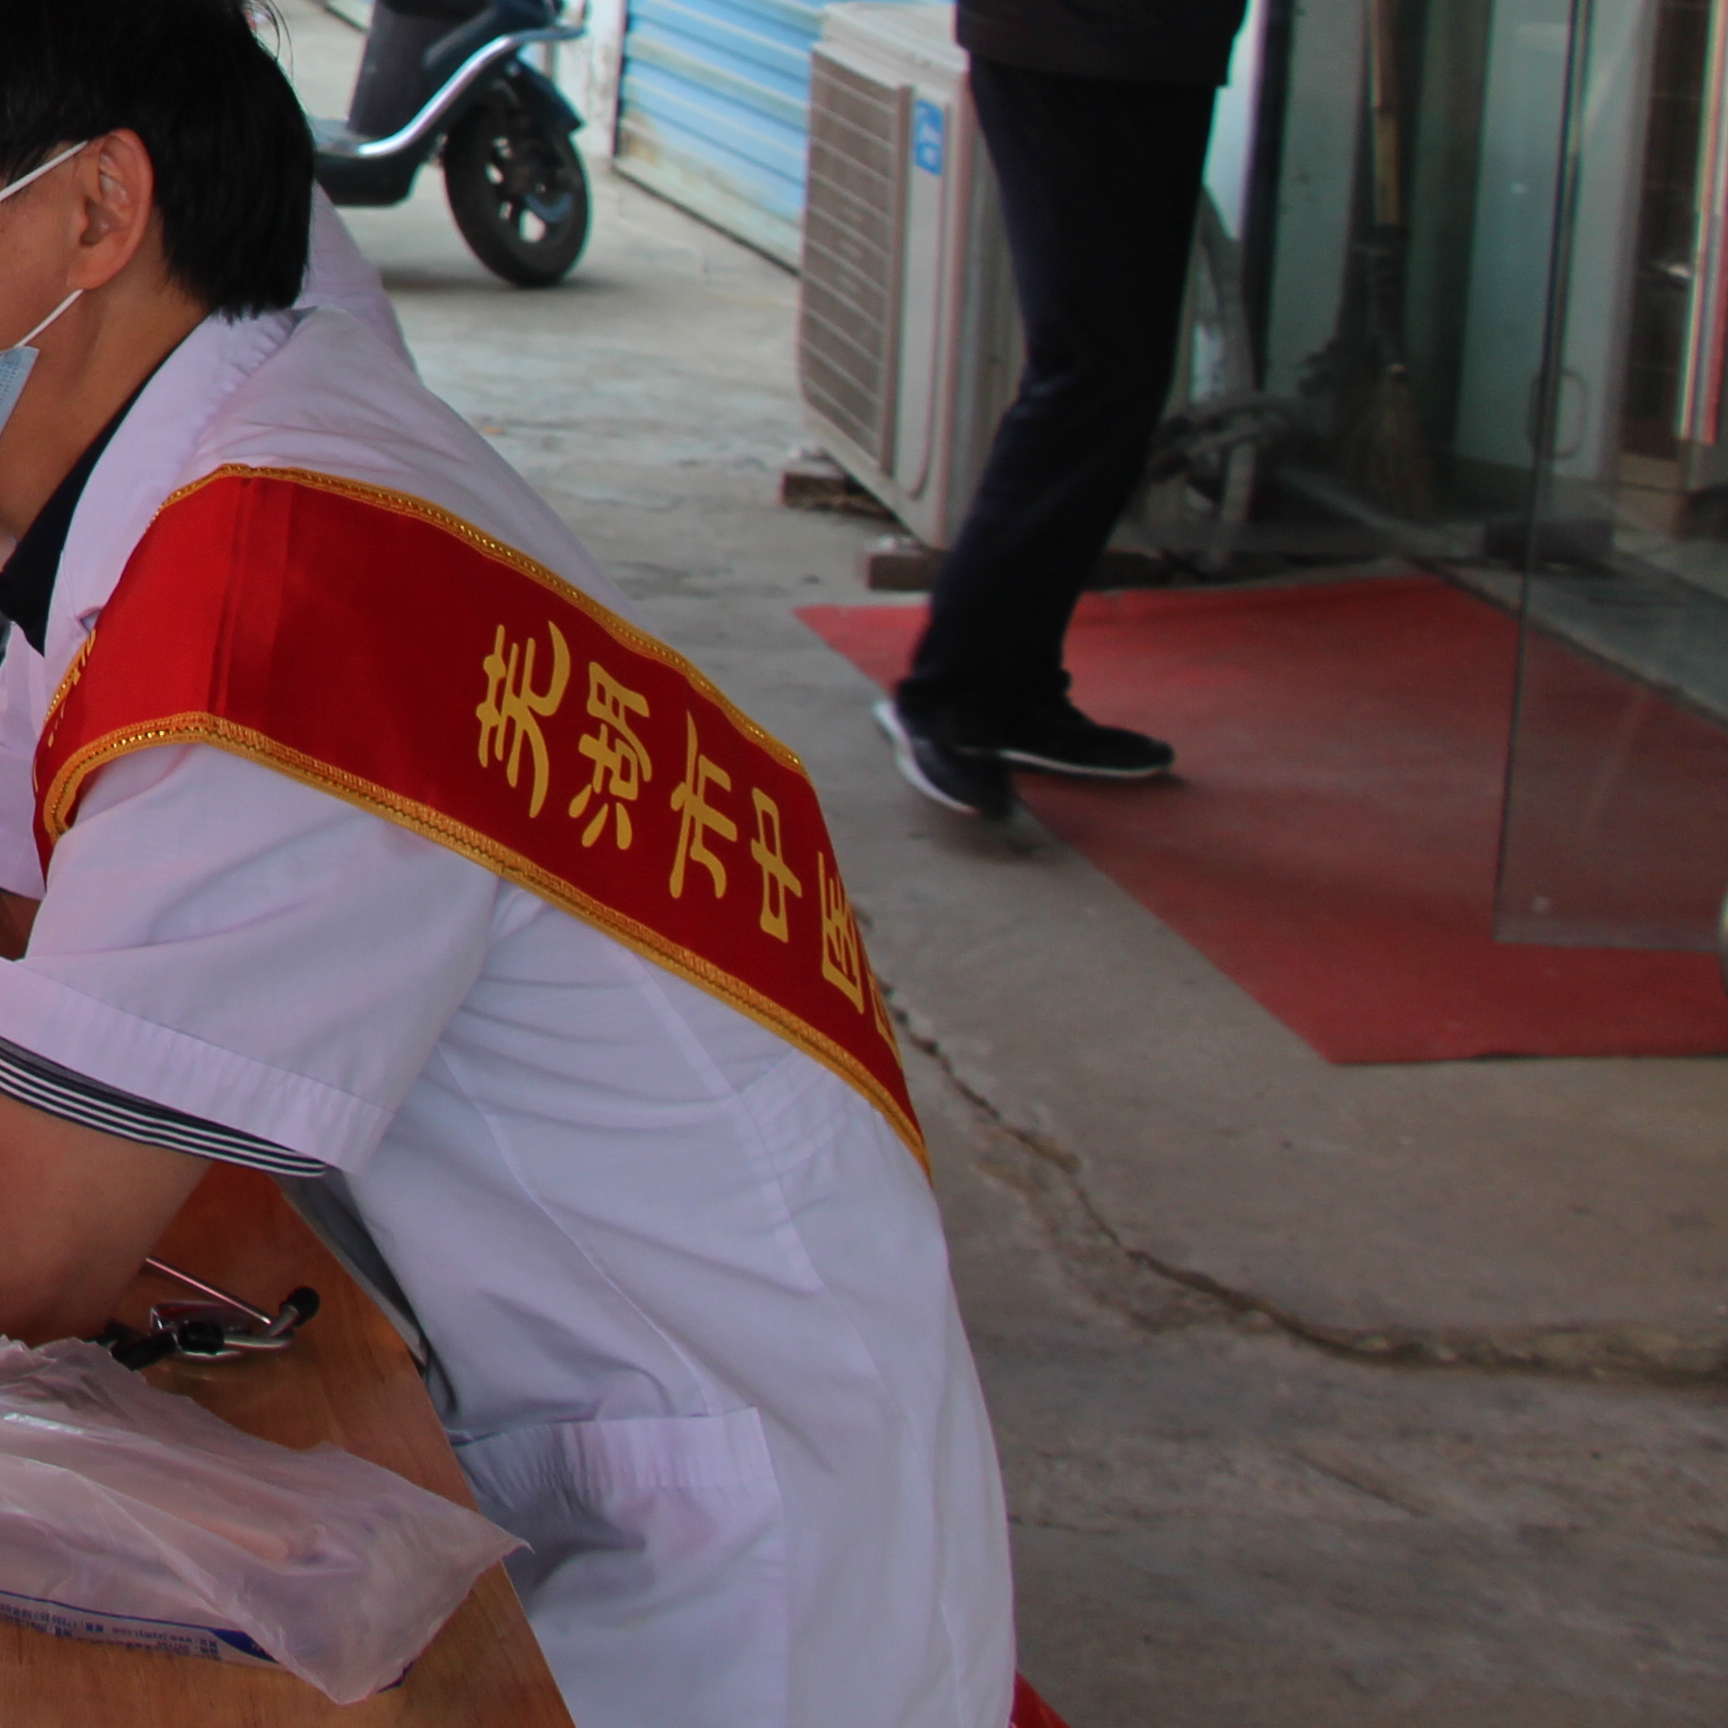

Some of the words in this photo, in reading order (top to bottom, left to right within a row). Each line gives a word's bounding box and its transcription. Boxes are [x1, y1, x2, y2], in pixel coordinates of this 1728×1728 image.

[478, 620, 902, 1069] 芜湖市中医
